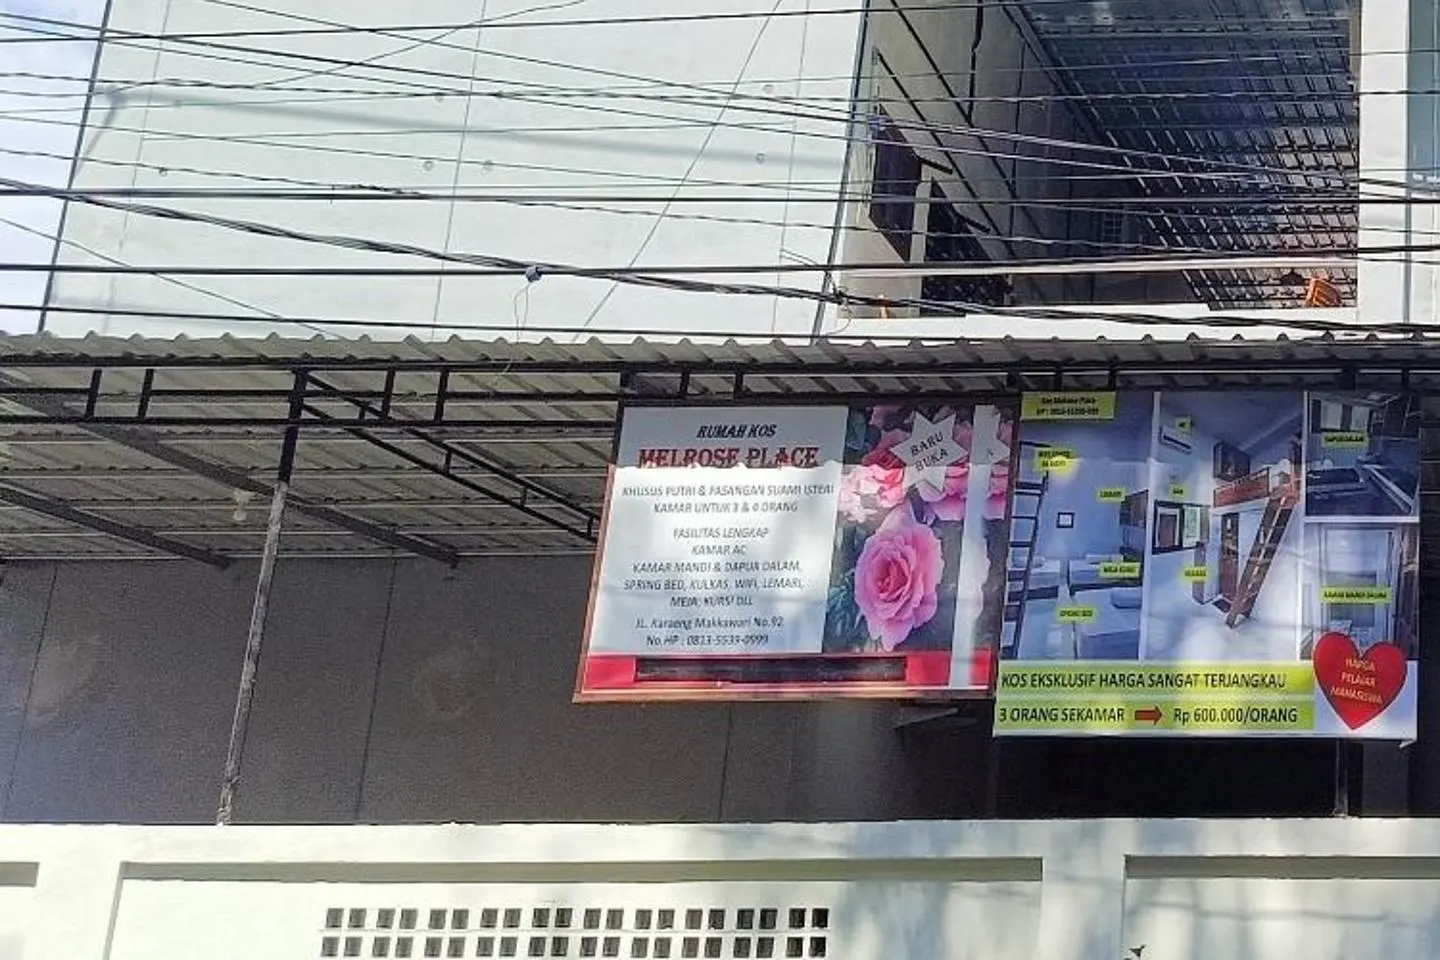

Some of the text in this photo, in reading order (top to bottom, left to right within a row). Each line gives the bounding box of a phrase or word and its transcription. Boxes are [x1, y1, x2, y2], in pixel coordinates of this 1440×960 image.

[696, 423, 777, 439] RUMAH KOS
[910, 430, 944, 457] BARU
[638, 446, 820, 468] MELROSE PLACE
[915, 448, 949, 471] BUKA
[622, 485, 663, 497] KHUSUS
[666, 485, 697, 497] PUTRI
[699, 485, 707, 496] &
[708, 484, 764, 496] PASANGAN
[767, 484, 801, 496] SUAMI
[654, 502, 691, 514] KAMAR
[695, 502, 732, 513] UNTUK
[761, 501, 798, 513] ORANG
[673, 527, 769, 539] FASILITAS LENGKAP
[691, 544, 748, 556] KAMAR AC
[633, 562, 672, 574] KAMAR
[674, 562, 710, 573] MANDI
[713, 562, 721, 573] &
[724, 561, 760, 573] DAPUR
[624, 579, 661, 591] SPRING
[753, 616, 784, 628] No.92
[1001, 673, 1286, 689] KOS EKSKLUSIF HARGA SANGAT TERJANGKAU
[999, 706, 1298, 725] 3 ORANG SEKAMAR Rp 600.000/ORANG
